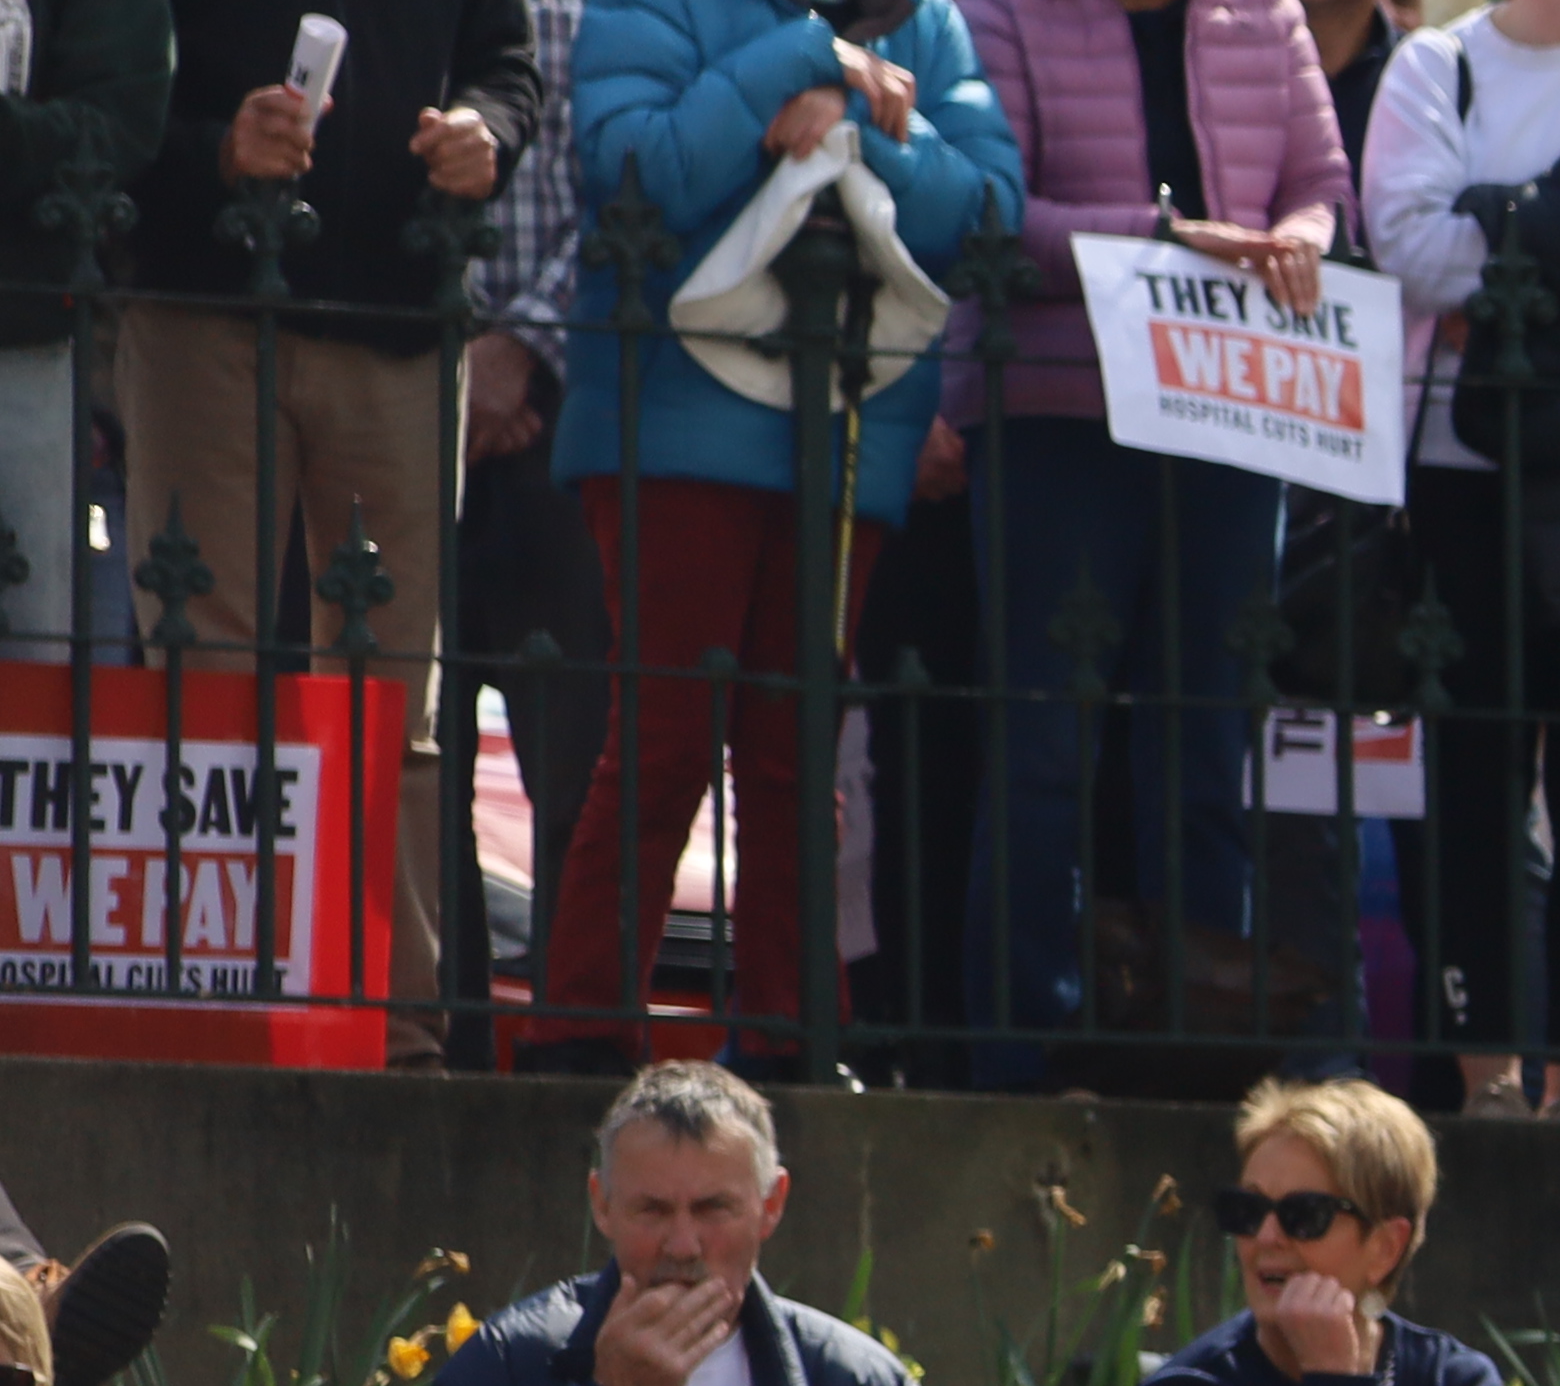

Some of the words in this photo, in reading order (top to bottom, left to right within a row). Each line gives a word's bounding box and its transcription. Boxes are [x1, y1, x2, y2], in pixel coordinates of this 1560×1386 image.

[1135, 271, 1248, 324] THEY
[1167, 326, 1257, 399] WE
[1261, 344, 1346, 420] PAY
[1159, 394, 1256, 436] HOSPITAL
[1262, 417, 1310, 449] CUTS
[1316, 432, 1364, 463] HURT
[0, 758, 143, 836] THEY
[159, 765, 298, 838] SAVE
[10, 852, 130, 947] WE
[141, 856, 260, 950] PAY
[0, 957, 114, 989] OSPIAL
[126, 963, 203, 994] CUS
[210, 968, 288, 996] HUT
